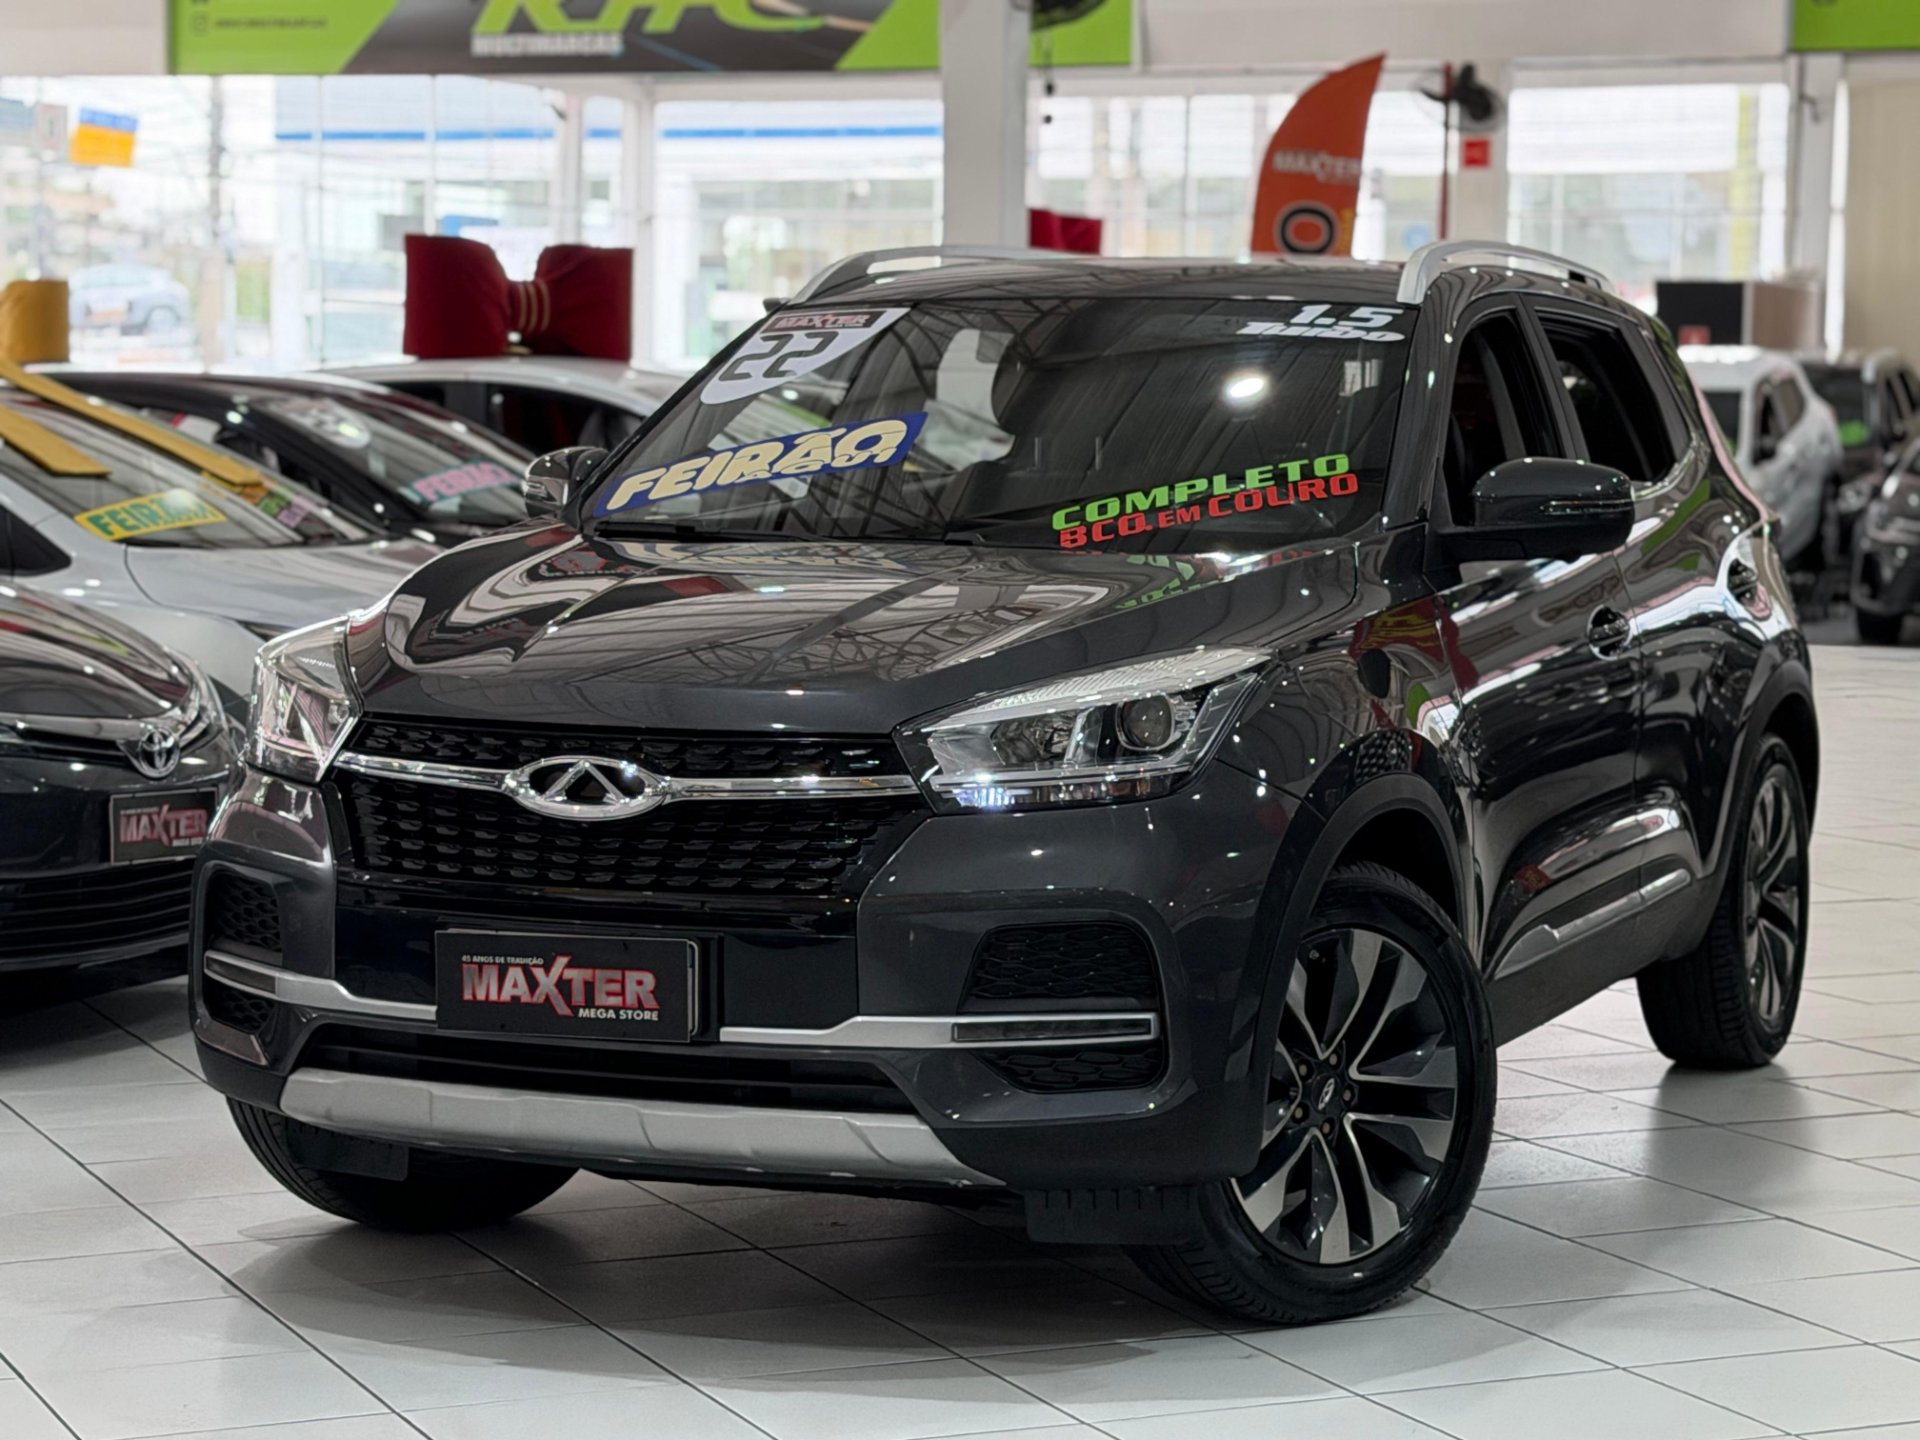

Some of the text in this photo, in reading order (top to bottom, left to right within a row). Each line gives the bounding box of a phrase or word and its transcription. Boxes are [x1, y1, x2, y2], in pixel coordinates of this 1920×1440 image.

[774, 313, 871, 328] MAXTER
[1289, 303, 1404, 328] 1.5
[717, 330, 840, 382] 22
[606, 419, 908, 511] FEIRÃO
[1052, 453, 1349, 530] COMPLETO
[1158, 505, 1200, 528] EM
[1208, 473, 1359, 518] COURO
[120, 802, 208, 846] MAXTER
[472, 955, 494, 963] ANOS
[495, 956, 505, 964] DE
[506, 956, 544, 965] TRADIÇÃO
[462, 954, 660, 1017] MAXTER
[578, 1008, 659, 1021] MEGA STORE
